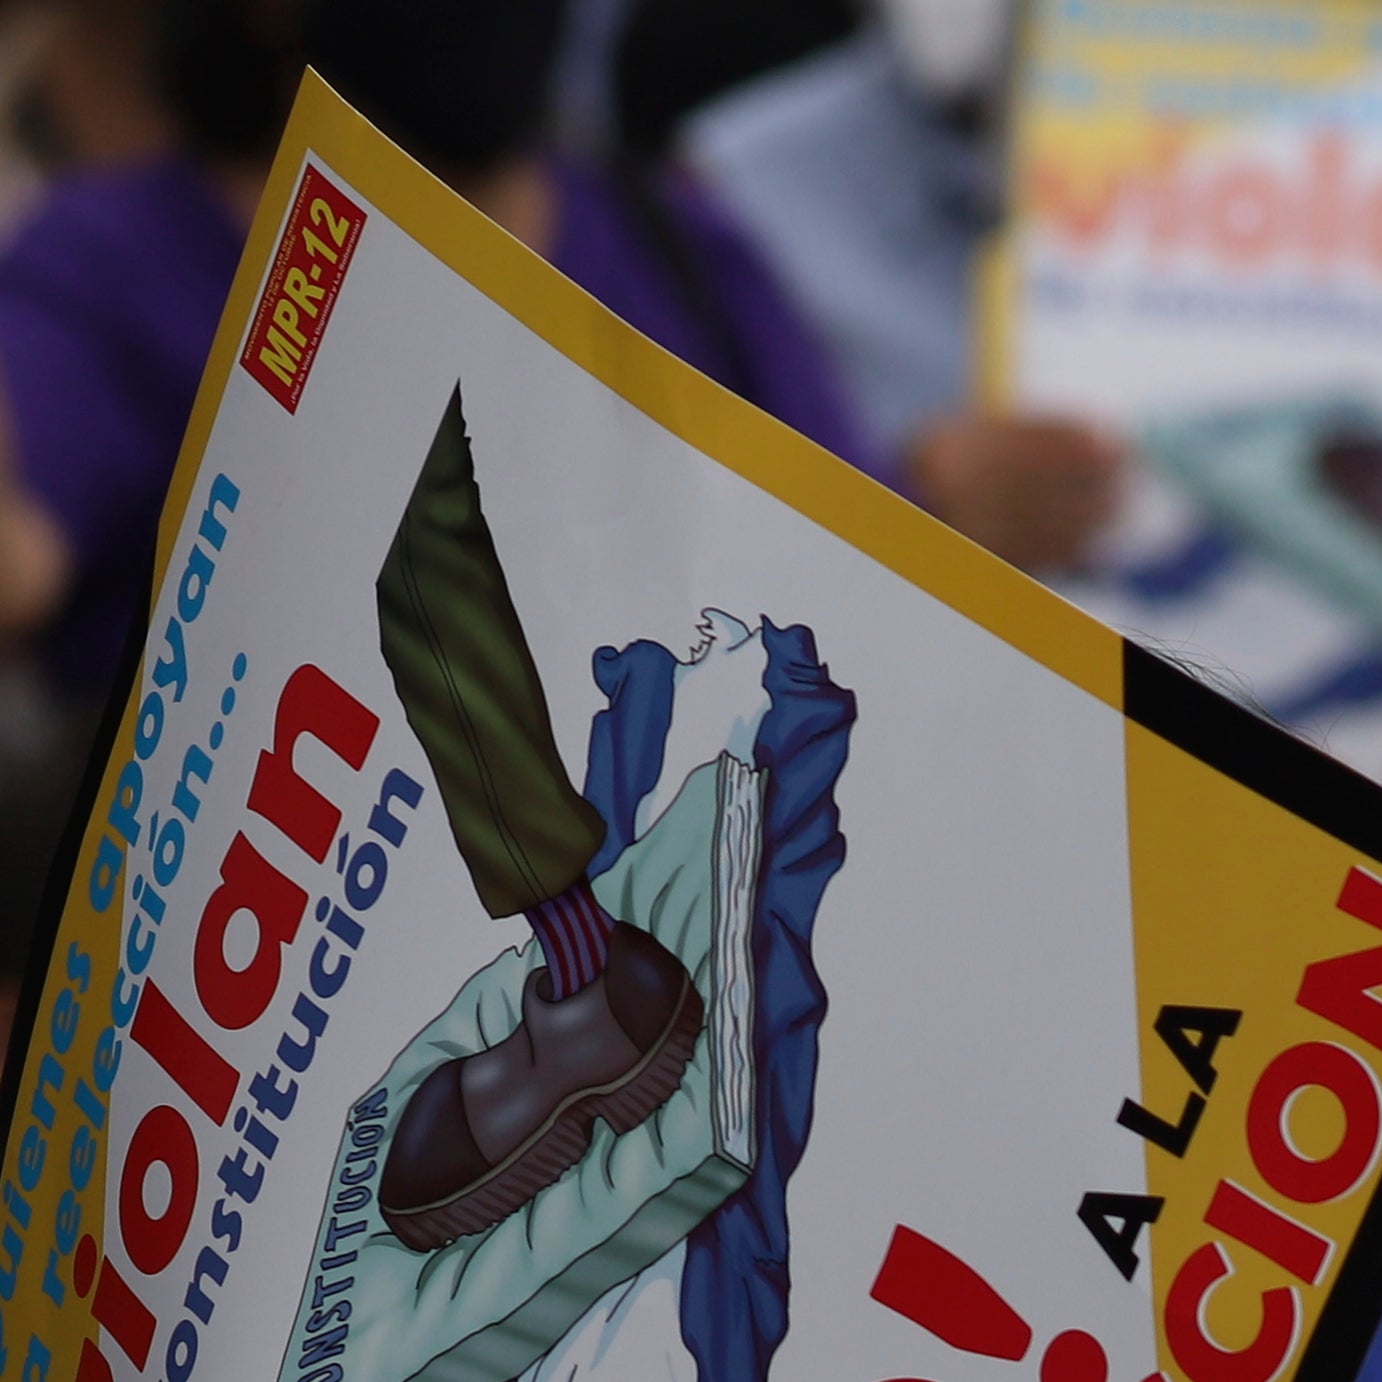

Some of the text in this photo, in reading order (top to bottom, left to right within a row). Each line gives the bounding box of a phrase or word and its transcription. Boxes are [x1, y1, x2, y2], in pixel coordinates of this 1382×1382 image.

[259, 197, 350, 388] MPR-12
[0, 472, 241, 1376] uienes apoyan
[42, 652, 247, 1308] reelección...
[1076, 1003, 1243, 1282] A LA
